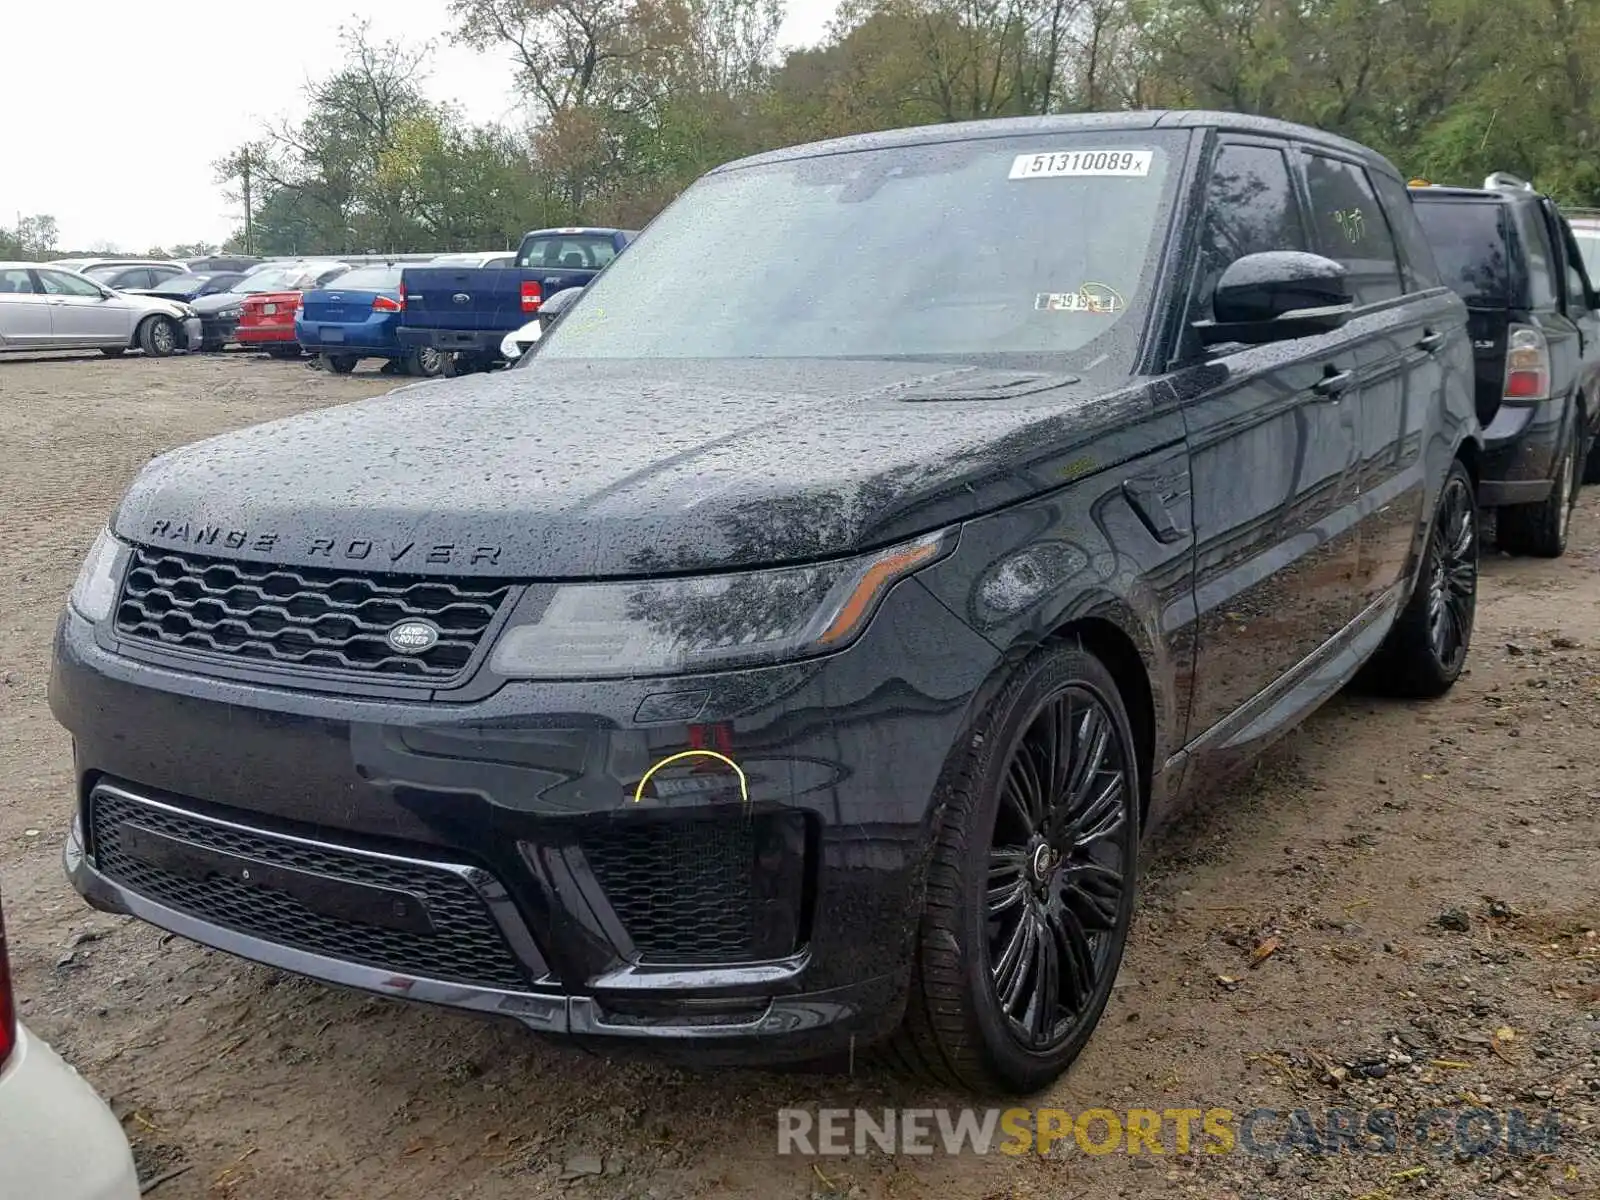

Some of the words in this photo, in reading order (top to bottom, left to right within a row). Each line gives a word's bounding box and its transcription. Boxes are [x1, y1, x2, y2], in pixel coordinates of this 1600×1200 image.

[151, 519, 279, 552] RANGE
[307, 538, 502, 565] ROVER
[399, 626, 425, 635] LAND
[399, 635, 429, 645] ROVER
